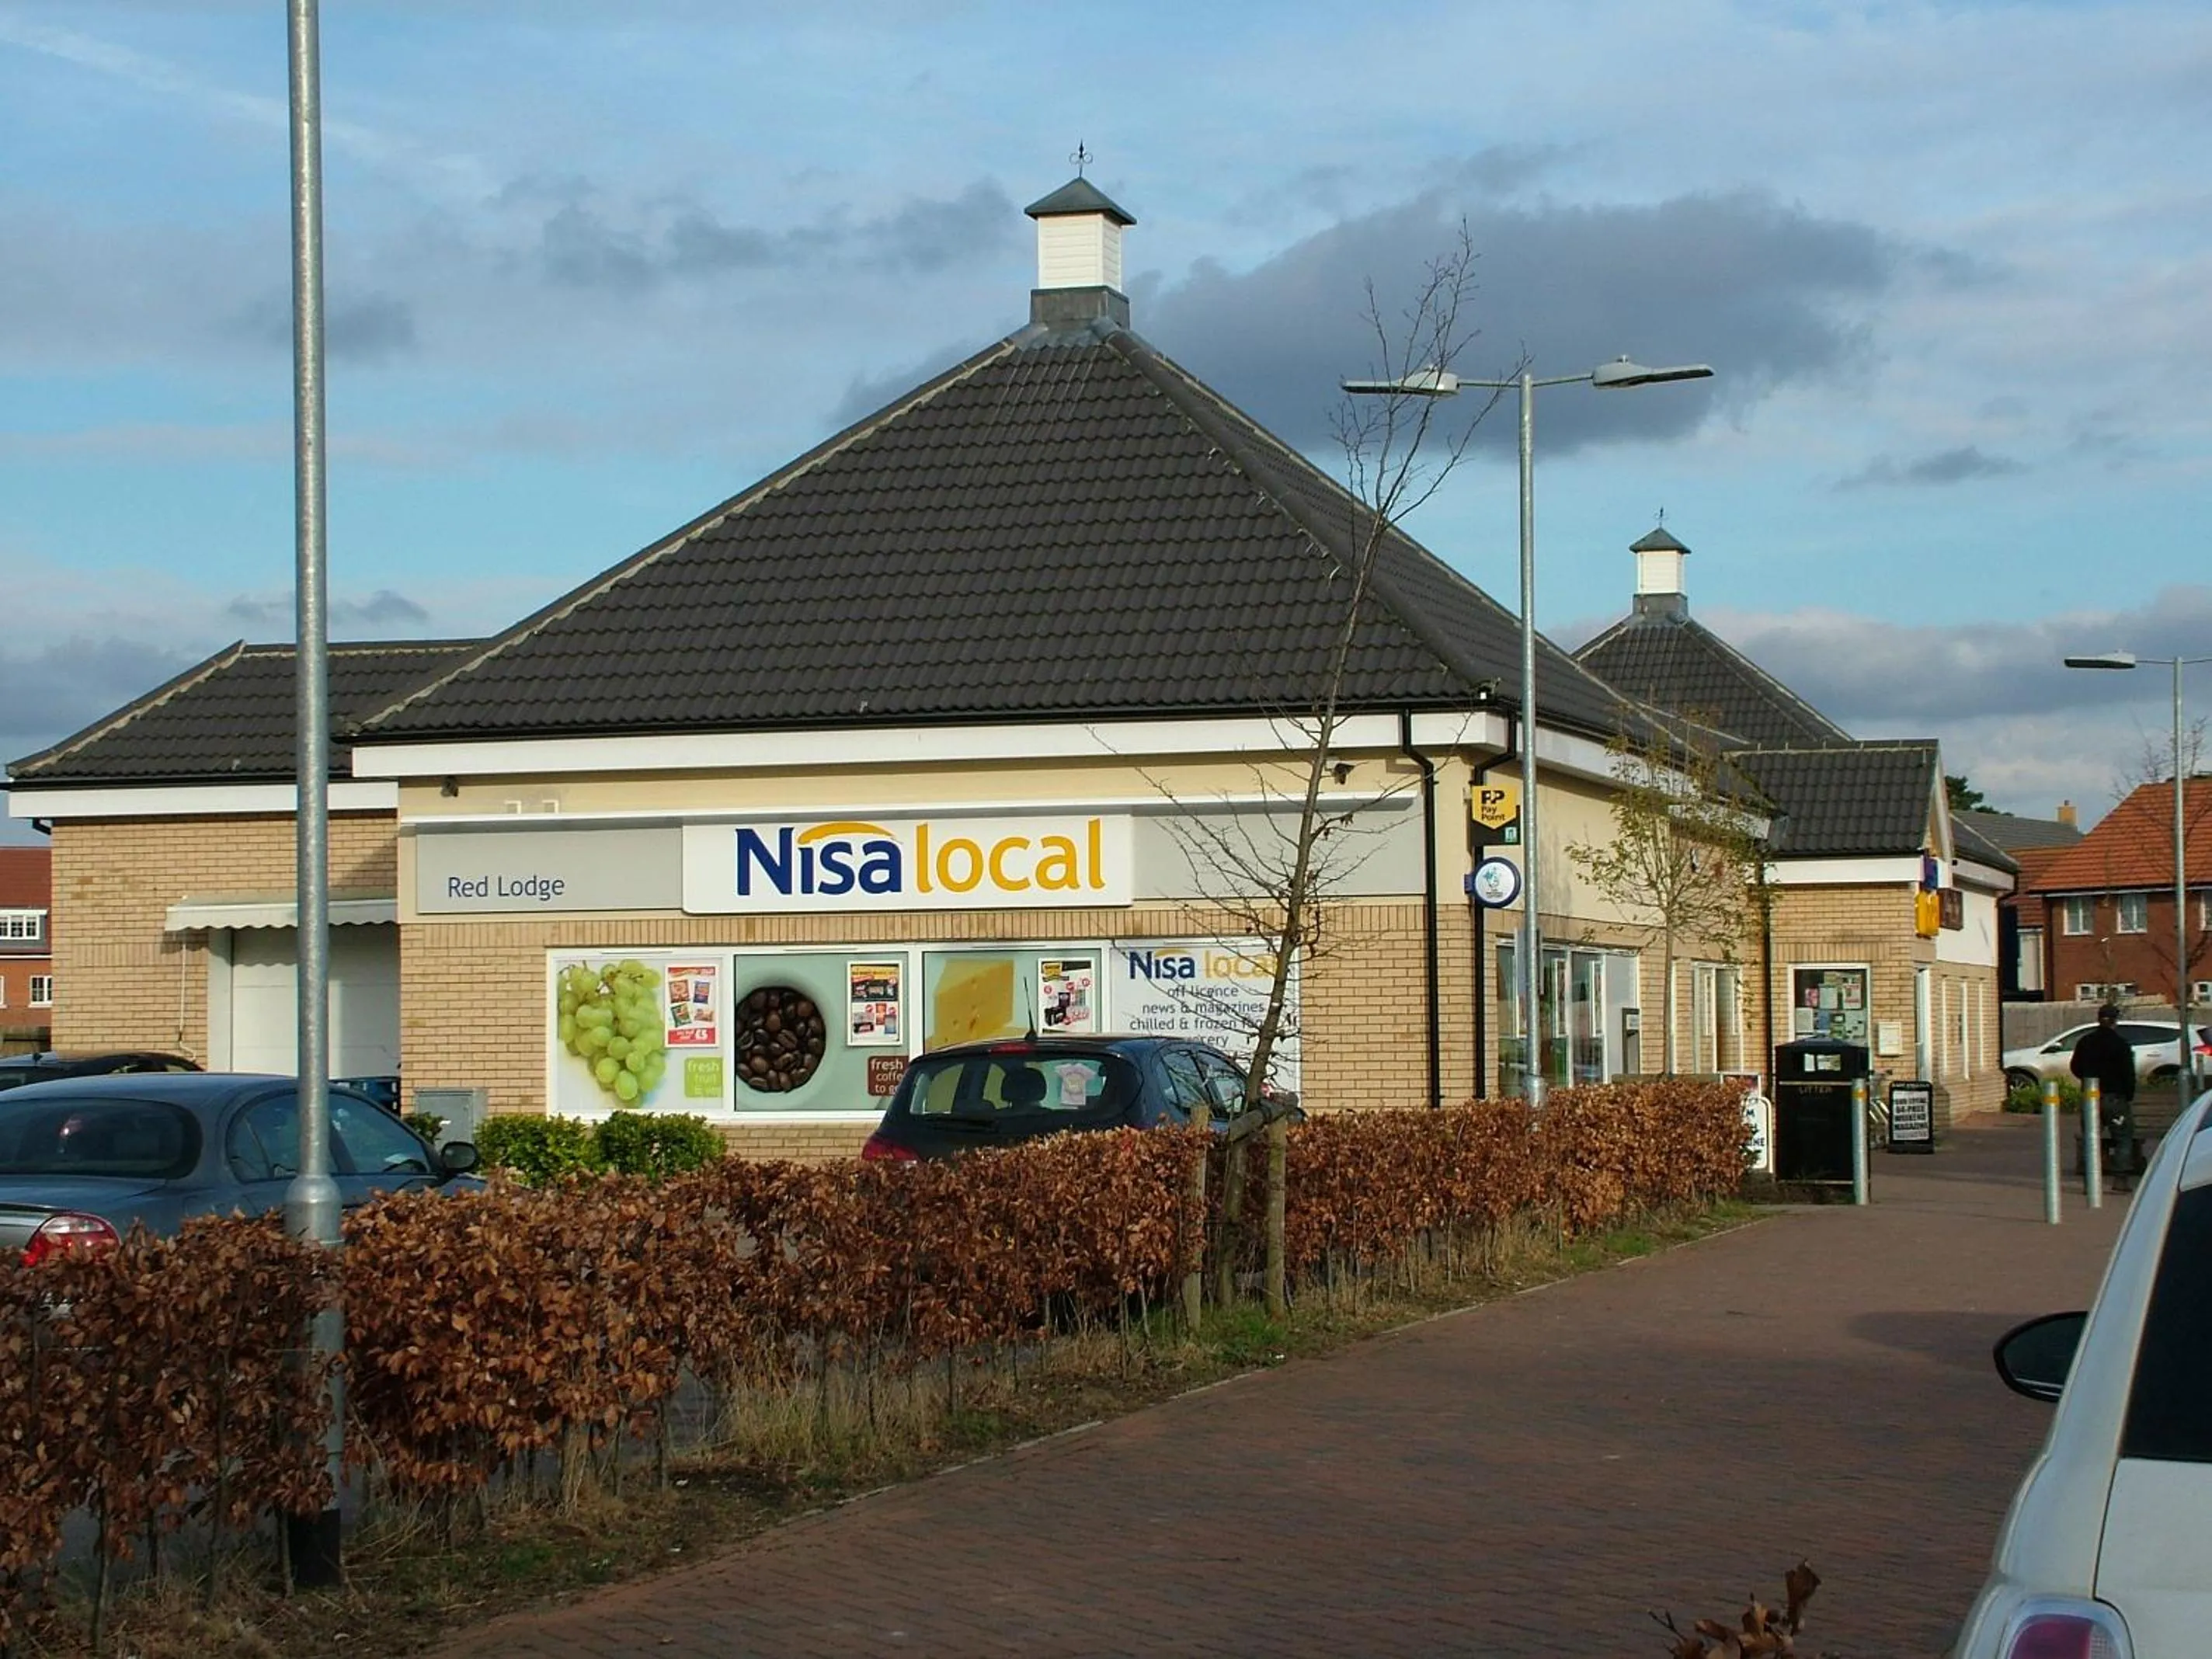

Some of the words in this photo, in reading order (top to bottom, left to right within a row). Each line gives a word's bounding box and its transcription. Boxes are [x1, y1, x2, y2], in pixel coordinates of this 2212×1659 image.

[1481, 806, 1497, 816] Pay
[735, 822, 903, 896] Nisa
[916, 818, 1106, 893] local
[448, 876, 488, 897] Red
[498, 875, 565, 901] Lodge
[1129, 948, 1196, 979] Nisa
[1205, 951, 1278, 979] loca
[1191, 985, 1239, 997] licence
[1143, 1003, 1176, 1014] news
[1196, 1001, 1264, 1017] magazines
[1130, 1017, 1174, 1030] chilled
[1180, 1017, 1190, 1030] &
[1195, 1017, 1236, 1030] frozen
[687, 1059, 720, 1073] fresh
[871, 1058, 904, 1070] fresh
[875, 1069, 903, 1082] coffe
[875, 1084, 885, 1094] to
